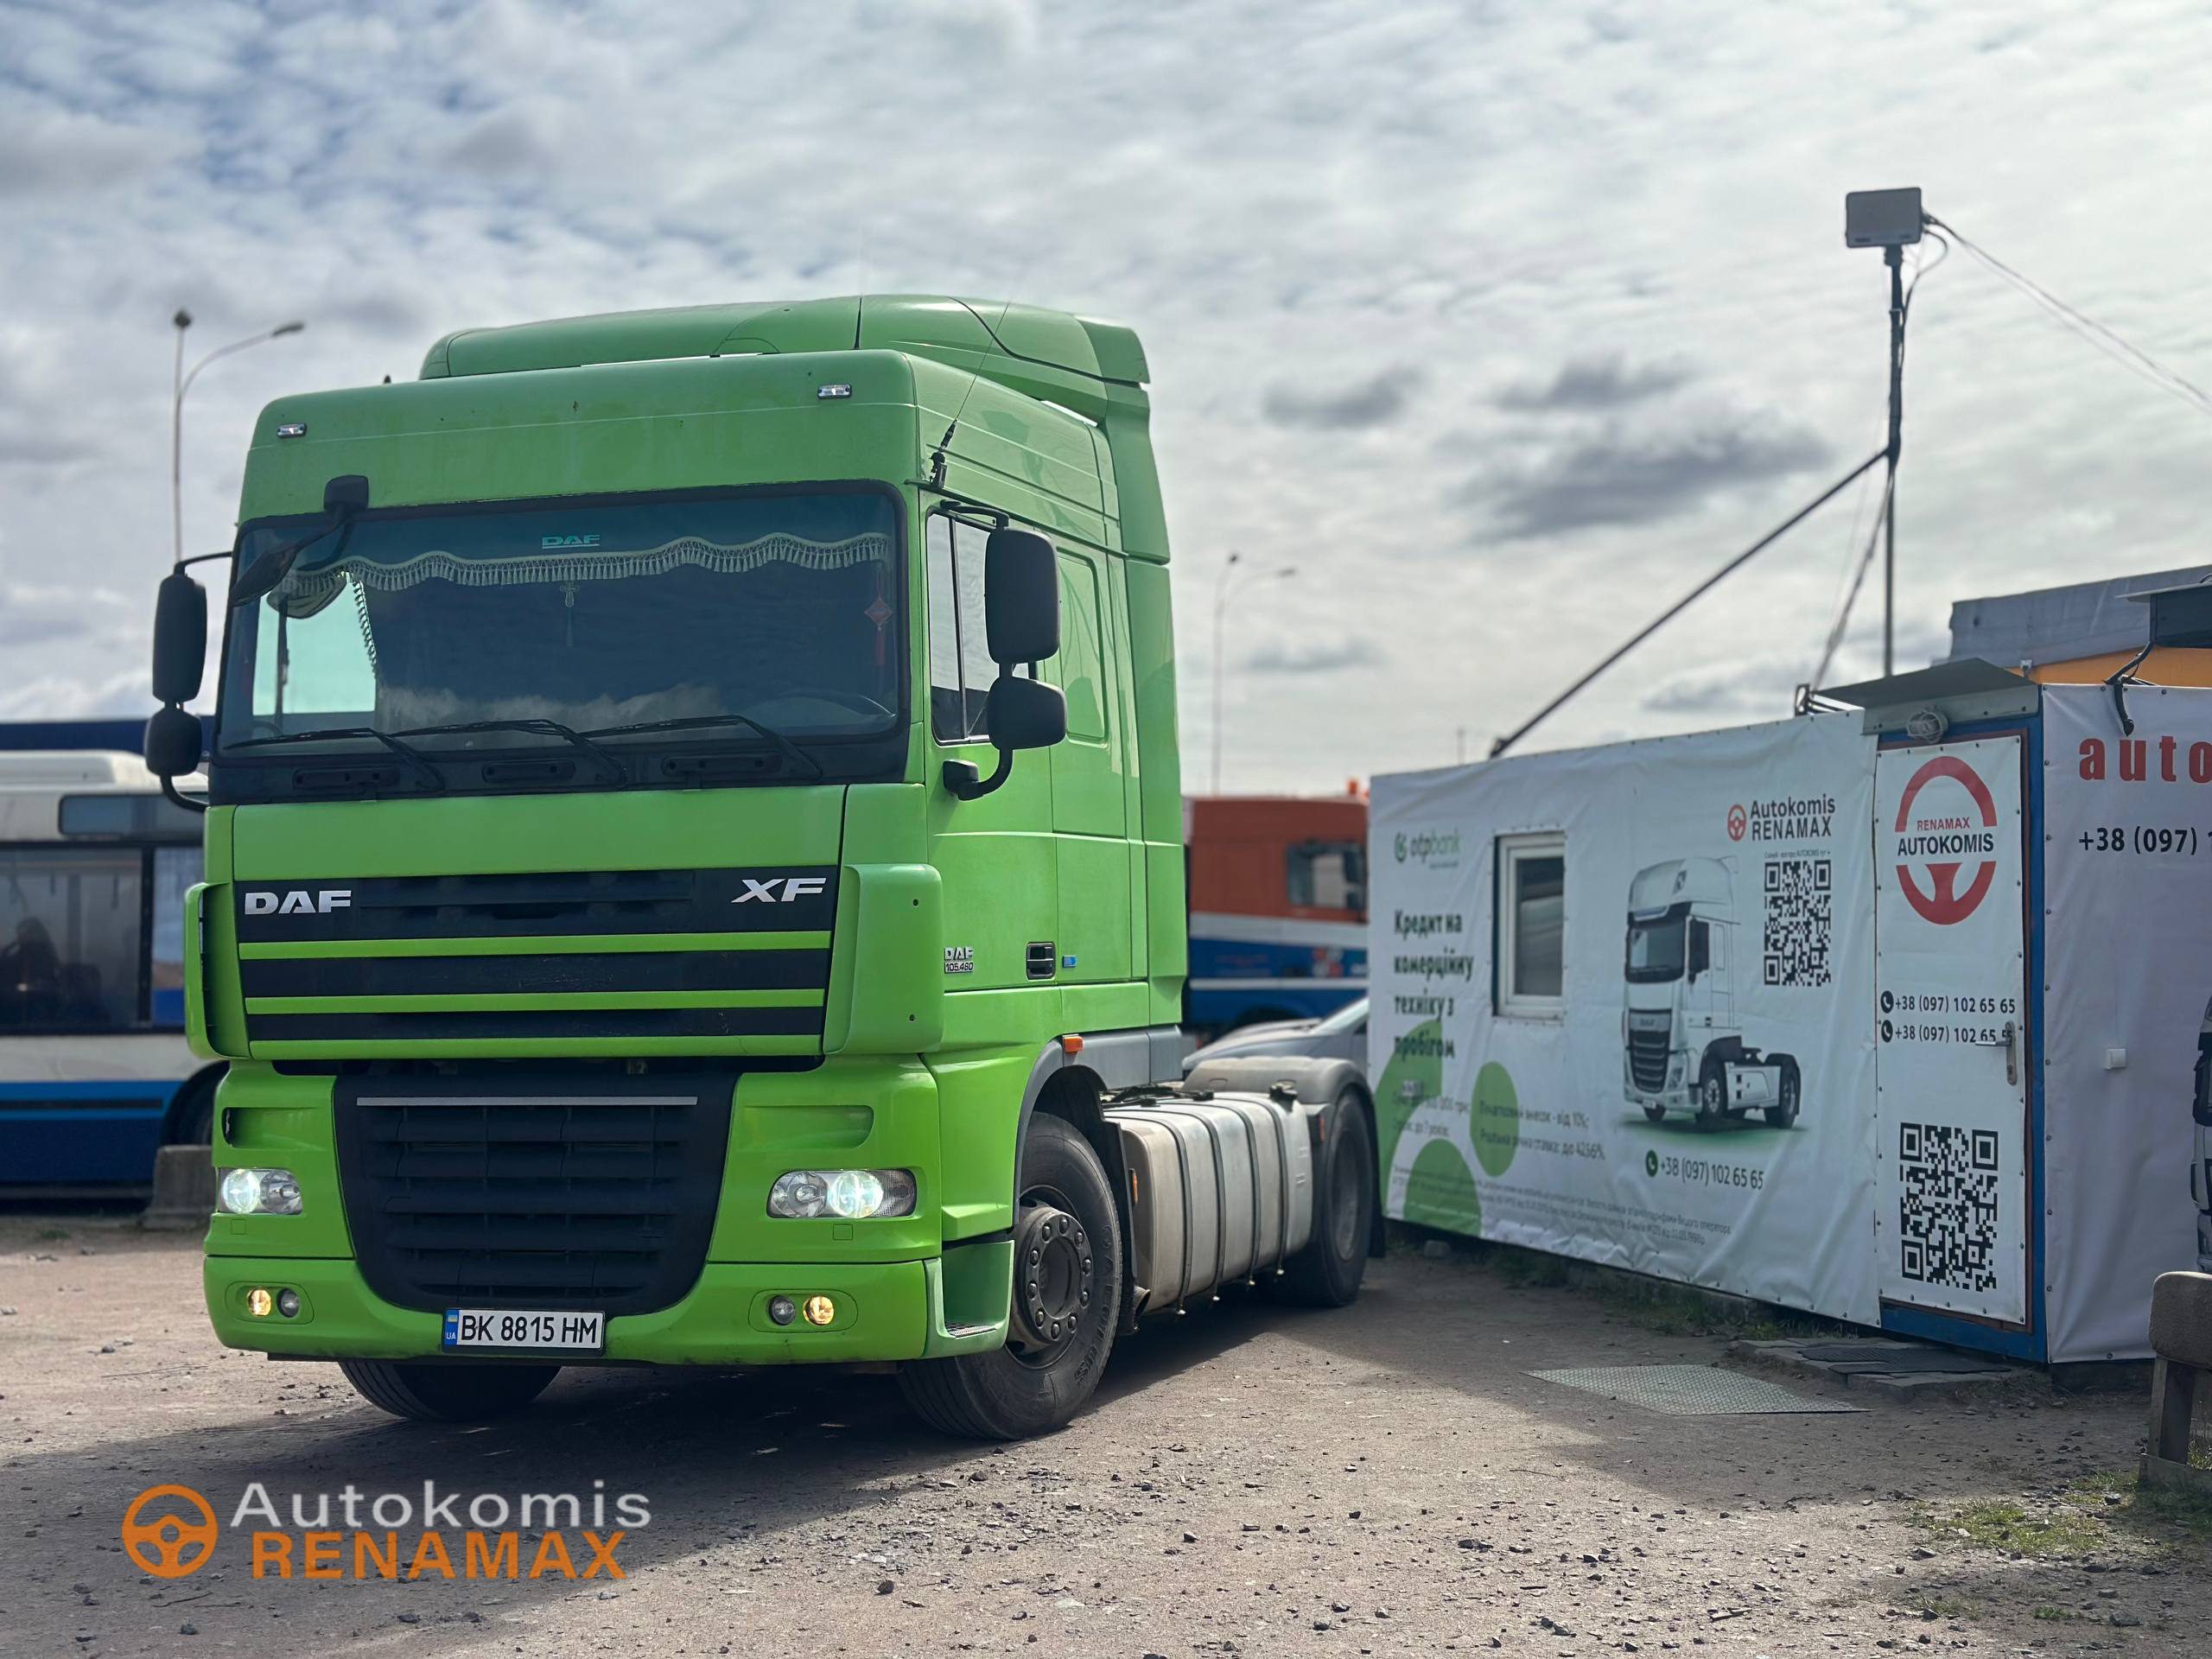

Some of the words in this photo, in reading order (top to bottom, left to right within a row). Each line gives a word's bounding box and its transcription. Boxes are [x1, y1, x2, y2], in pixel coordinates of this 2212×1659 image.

[542, 534, 600, 549] DAF
[1750, 793, 1836, 820] Autokomis
[1751, 815, 1832, 842] RENAMAX
[1916, 817, 1971, 831] RENAMAX
[1897, 833, 1994, 856] AUTOKOMIS
[2079, 827, 2125, 851] +38
[2134, 825, 2197, 855] (097)
[245, 890, 352, 915] DAF
[731, 878, 827, 903] XF
[1395, 910, 1442, 940] Кредит
[1446, 913, 1462, 932] на
[944, 947, 974, 960] DAF
[1395, 947, 1474, 982] комерційну
[1395, 988, 1444, 1022] техніку
[1895, 995, 1915, 1010] +38
[1919, 995, 1949, 1013] (097)
[1955, 997, 1976, 1013] 102
[1980, 998, 1995, 1014] 65
[1999, 999, 2016, 1014] 65
[1395, 1029, 1455, 1062] пробігом
[1895, 1026, 1916, 1039] +38
[1919, 1025, 1949, 1043] (097)
[1955, 1027, 1977, 1043] 102
[1661, 1156, 1680, 1177] +38
[1681, 1157, 1710, 1187] (097)
[1712, 1163, 1730, 1185] 102
[1732, 1167, 1747, 1188] 65
[1750, 1169, 1764, 1191] 65
[446, 1332, 456, 1340] UA
[500, 1316, 554, 1342] 8815
